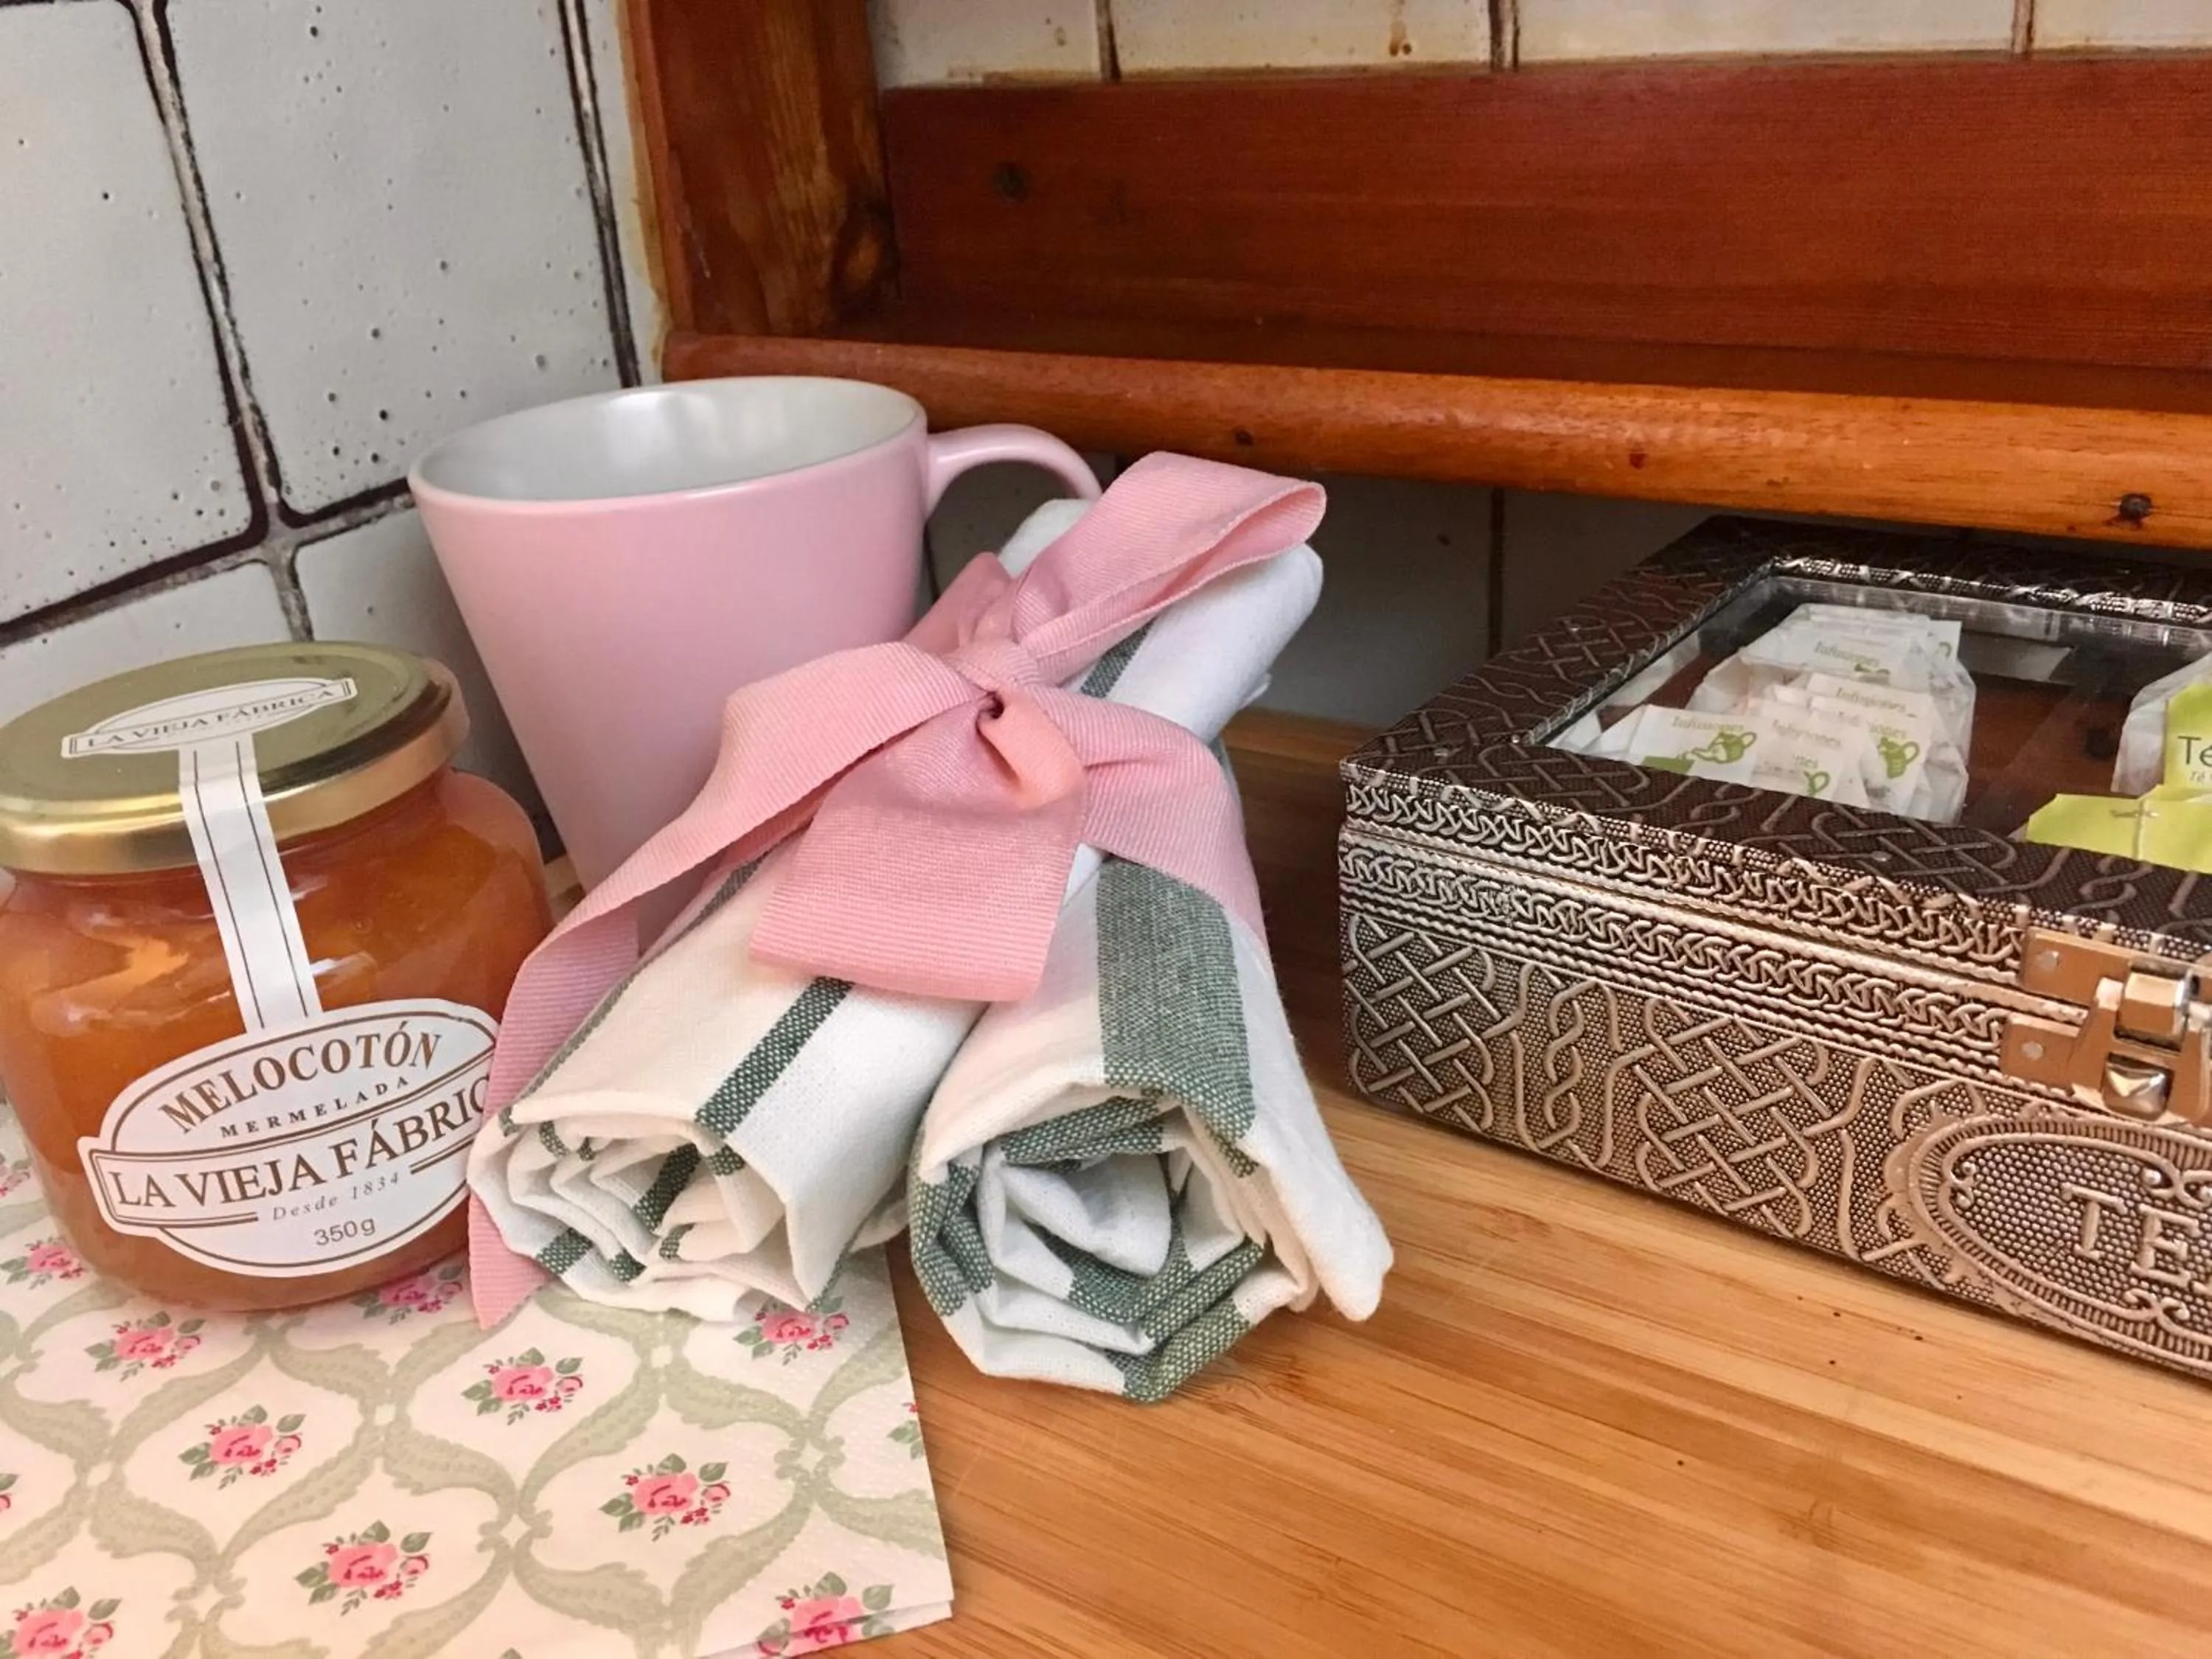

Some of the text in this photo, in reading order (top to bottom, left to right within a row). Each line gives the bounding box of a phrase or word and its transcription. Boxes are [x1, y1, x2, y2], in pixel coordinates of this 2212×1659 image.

[88, 734, 125, 748] LA
[133, 717, 209, 738] VIEJA
[158, 1020, 443, 1135] MELOCOTÓN
[221, 1079, 408, 1138] MERMELADA
[108, 1074, 490, 1208] LA VIEJA FÁBRIC
[273, 1172, 400, 1221] Desde 1834
[2061, 1181, 2212, 1295] TE
